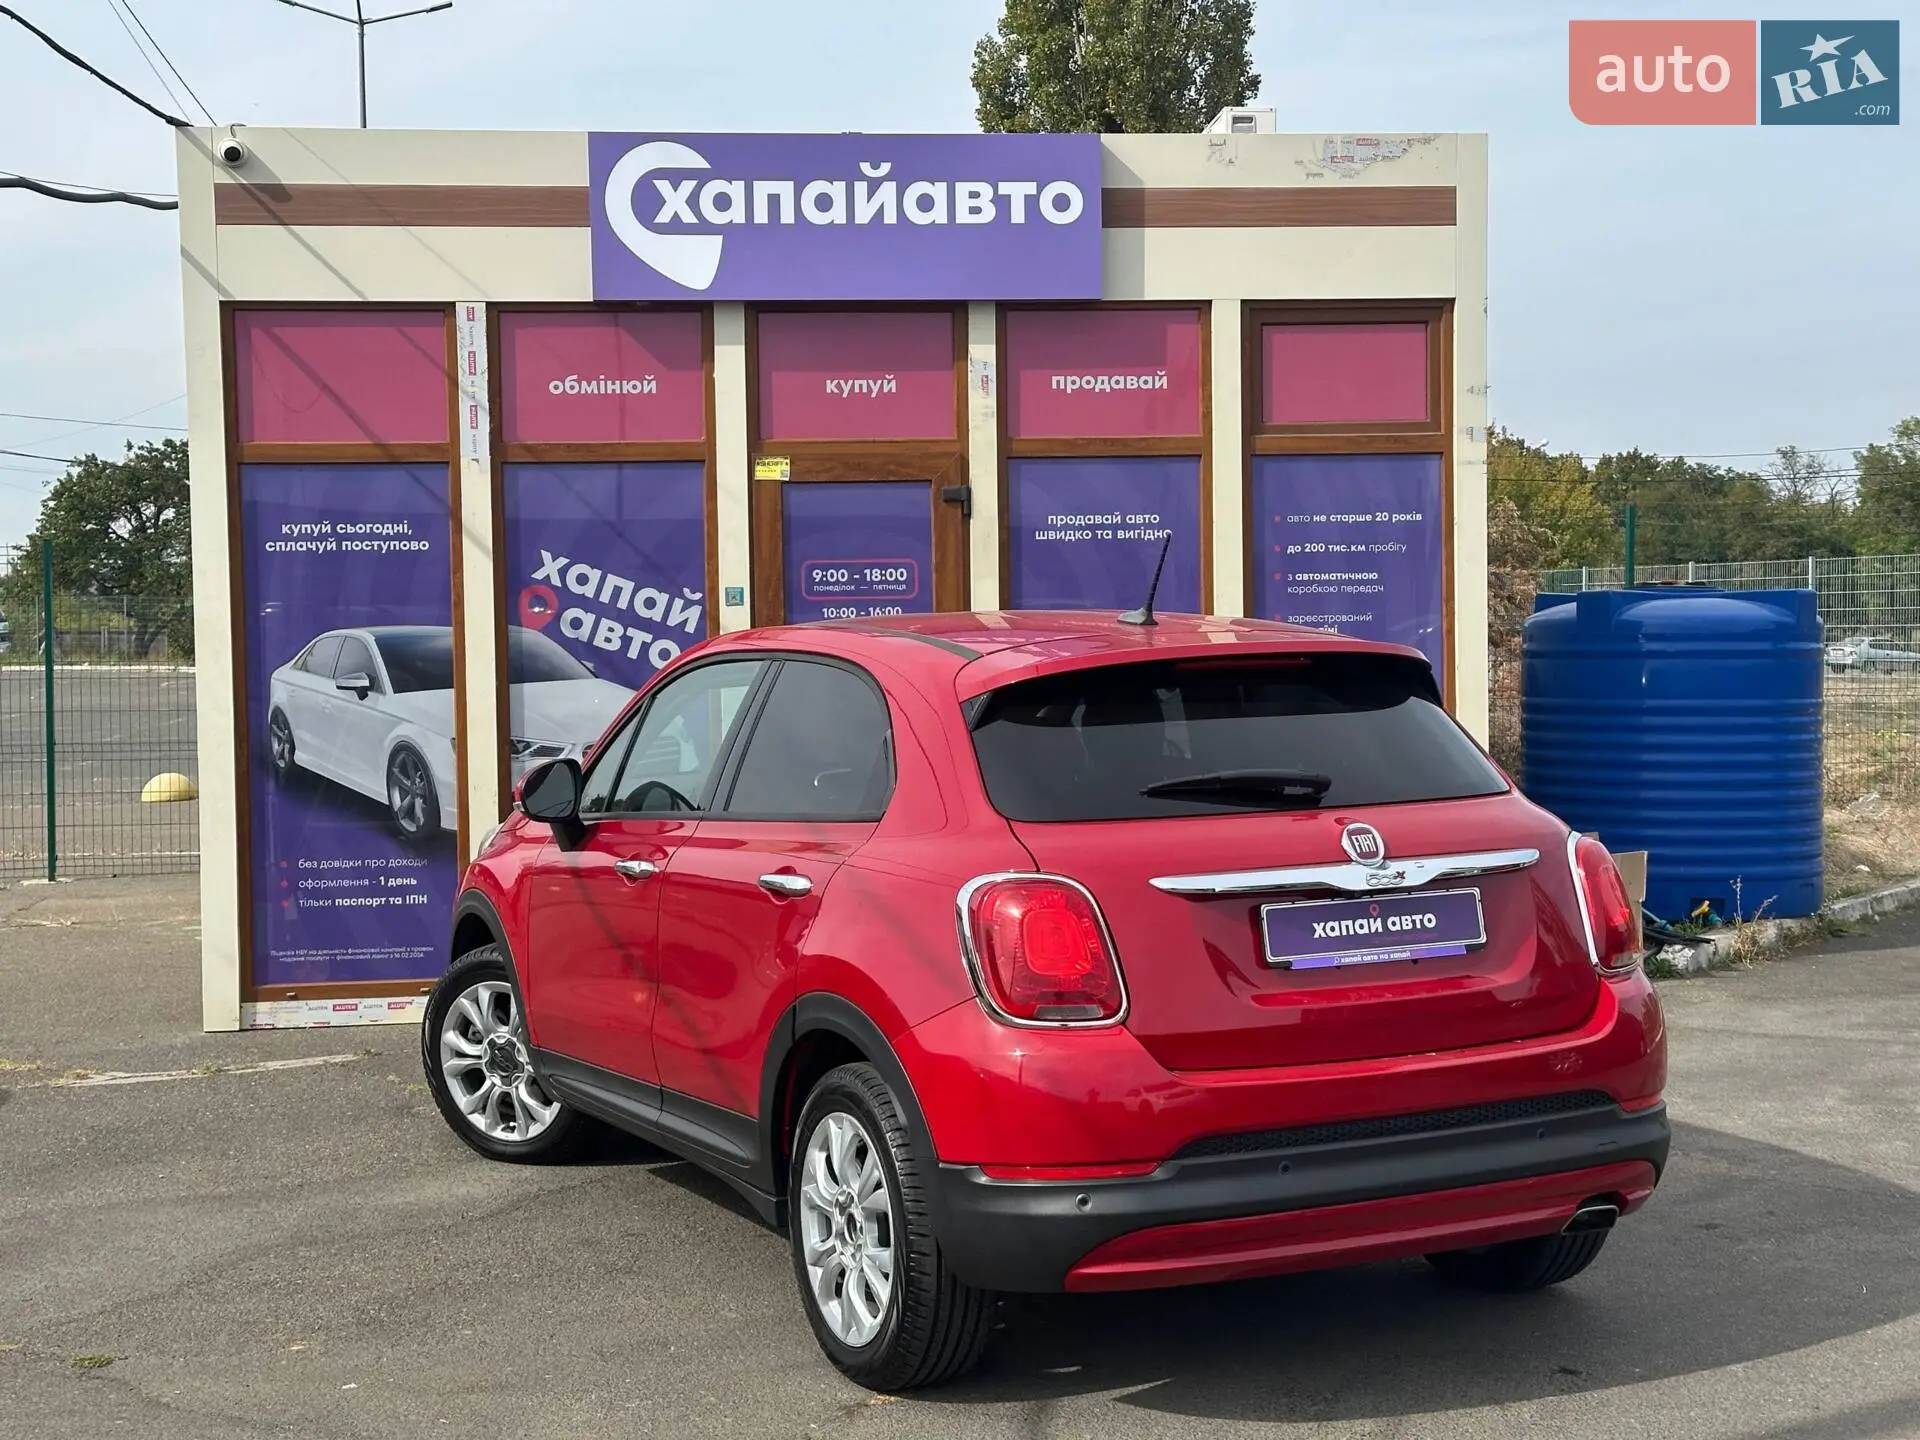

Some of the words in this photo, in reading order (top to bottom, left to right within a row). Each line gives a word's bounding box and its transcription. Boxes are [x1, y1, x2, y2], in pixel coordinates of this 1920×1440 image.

[548, 374, 657, 396] обмінюй
[825, 373, 897, 398] купуй
[1051, 370, 1168, 395] продавай
[1048, 511, 1121, 527] продавай
[1126, 513, 1160, 524] авто
[1287, 514, 1311, 523] авто
[1313, 514, 1327, 522] не
[1330, 512, 1372, 524] старше
[1375, 512, 1389, 521] 20
[1392, 511, 1423, 523] років
[281, 520, 332, 537] купуй
[336, 520, 413, 536] сьогодні,
[1035, 529, 1092, 542] швидко
[1096, 530, 1113, 540] та
[265, 537, 337, 554] сплачуй
[341, 539, 430, 554] поступово
[1287, 545, 1301, 554] до
[1304, 543, 1326, 553] 200
[1368, 541, 1407, 554] пробігу
[812, 568, 849, 582] 9:00
[864, 568, 908, 581] 18:00
[1295, 571, 1378, 581] автоматичною
[530, 549, 703, 634] хапай
[813, 583, 855, 592] понеділок
[1287, 583, 1338, 595] коробкою
[1340, 584, 1384, 594] передач
[822, 607, 857, 618] 10:00
[868, 606, 902, 616] 16:00
[1287, 612, 1373, 623] зареєстрований
[559, 607, 681, 670] авто
[1351, 833, 1377, 853] FIAT
[298, 858, 318, 869] без
[320, 858, 362, 869] довідки
[364, 858, 386, 869] про
[388, 856, 428, 867] доходи
[298, 877, 369, 890] оформлення
[379, 876, 385, 886] 1
[387, 876, 418, 888] день
[299, 897, 332, 908] тільки
[335, 896, 387, 907] паспорт
[388, 896, 402, 905] та
[405, 894, 427, 904] ІПН
[1387, 913, 1437, 931] авто
[1341, 955, 1362, 963] хапай
